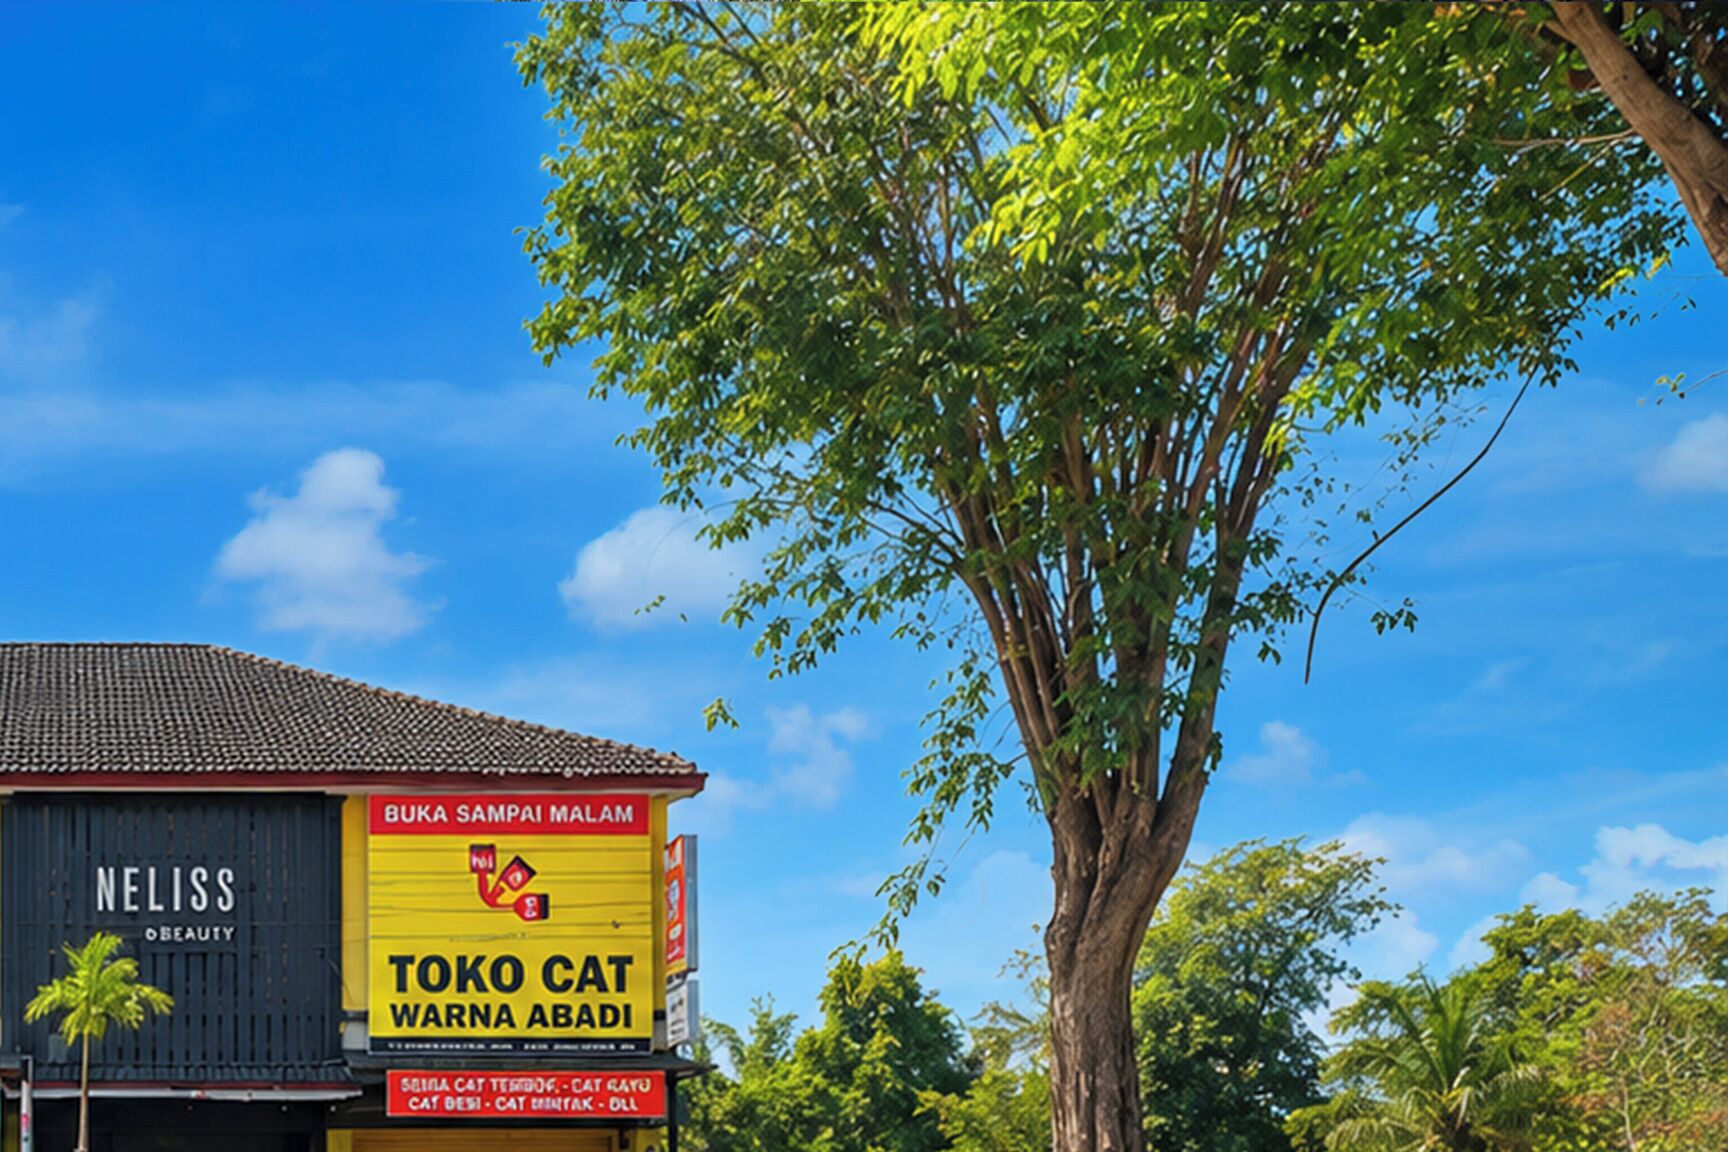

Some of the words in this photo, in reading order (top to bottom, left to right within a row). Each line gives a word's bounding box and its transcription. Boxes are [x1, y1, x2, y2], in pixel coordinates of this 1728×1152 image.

[384, 804, 448, 823] BUKA
[456, 804, 542, 823] SAMPAI
[550, 804, 634, 823] MALAM
[97, 866, 234, 912] NELISS
[388, 954, 525, 994] TOKO
[542, 954, 634, 994] CAT
[389, 1003, 517, 1029] WARNA
[526, 1003, 632, 1029] ABADI
[453, 1077, 485, 1092] CAT
[571, 1078, 603, 1093] CAT
[408, 1096, 440, 1111] CAT
[494, 1096, 527, 1111] CAT
